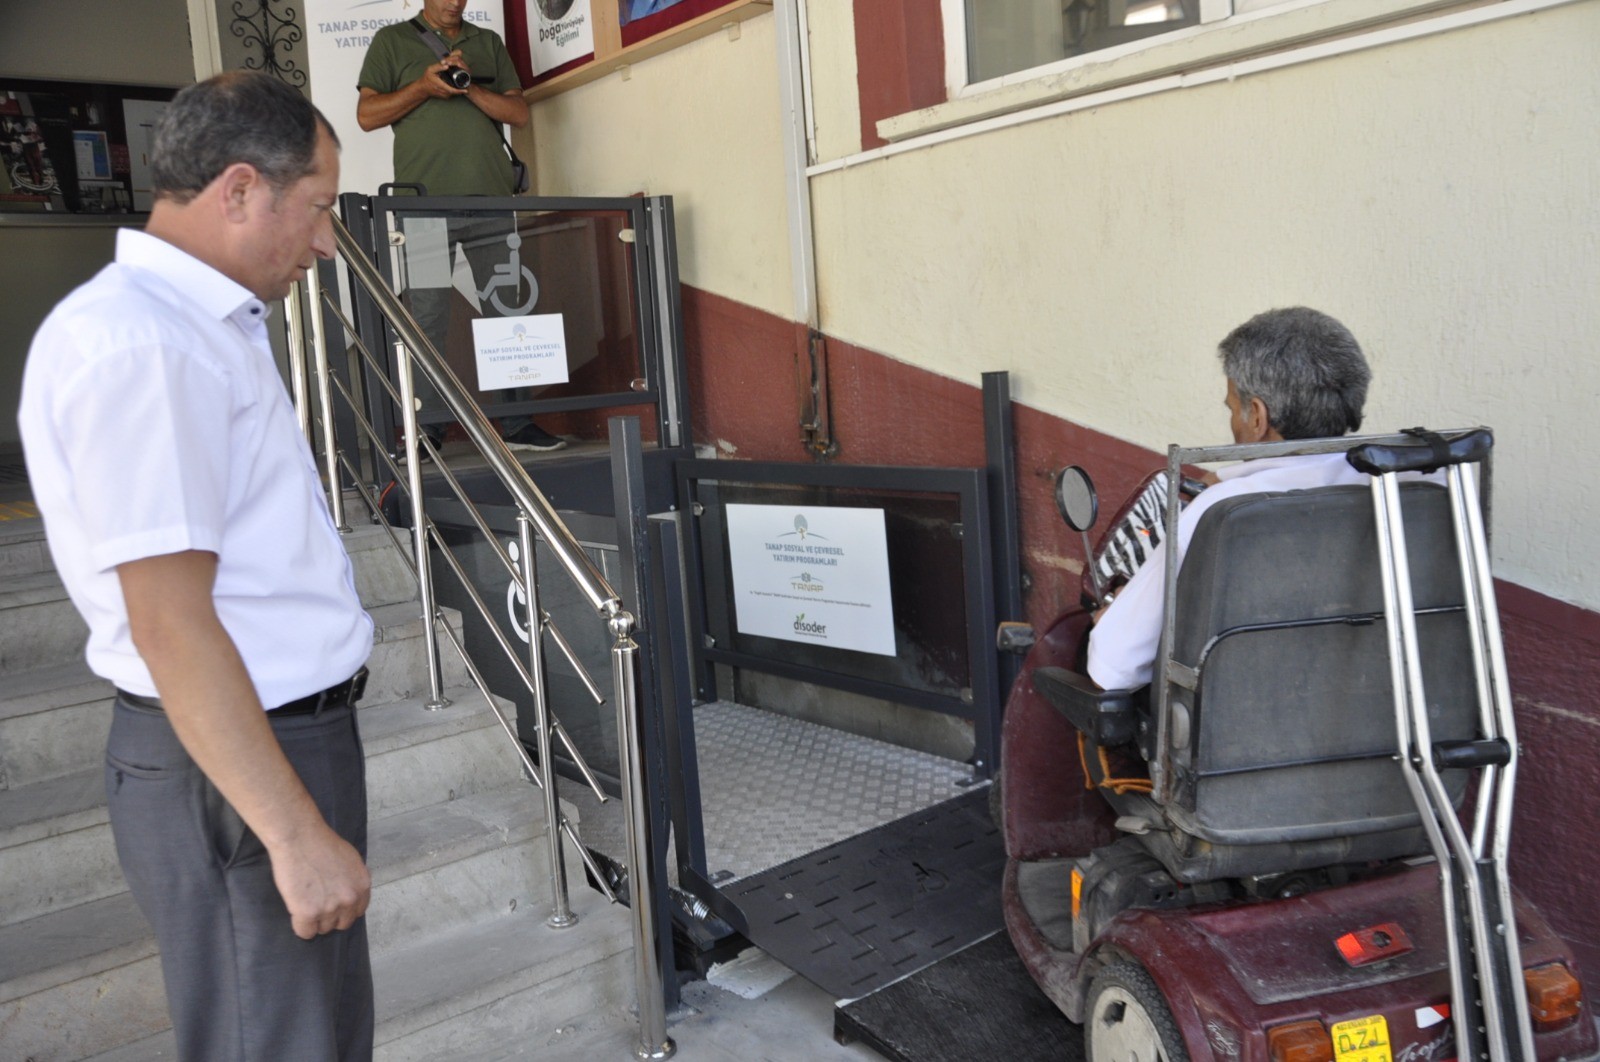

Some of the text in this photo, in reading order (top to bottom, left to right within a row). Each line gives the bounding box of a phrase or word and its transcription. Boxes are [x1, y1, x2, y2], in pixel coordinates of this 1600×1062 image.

[318, 20, 358, 33] TANAP
[539, 22, 561, 42] Doğa
[335, 35, 374, 48] YATIR
[556, 26, 580, 47] Eğitimi
[480, 347, 500, 355] TANAP
[501, 345, 523, 354] SOSYAL
[489, 351, 555, 363] YATIRIM PROGRAMLARI
[508, 372, 541, 382] TANAP
[765, 542, 845, 556] TANAP SOSYAL VE ÇEVRESEL
[773, 553, 838, 566] YATIRIM PROGRAMLARI
[791, 582, 824, 593] TANAP
[793, 619, 827, 635] disoder
